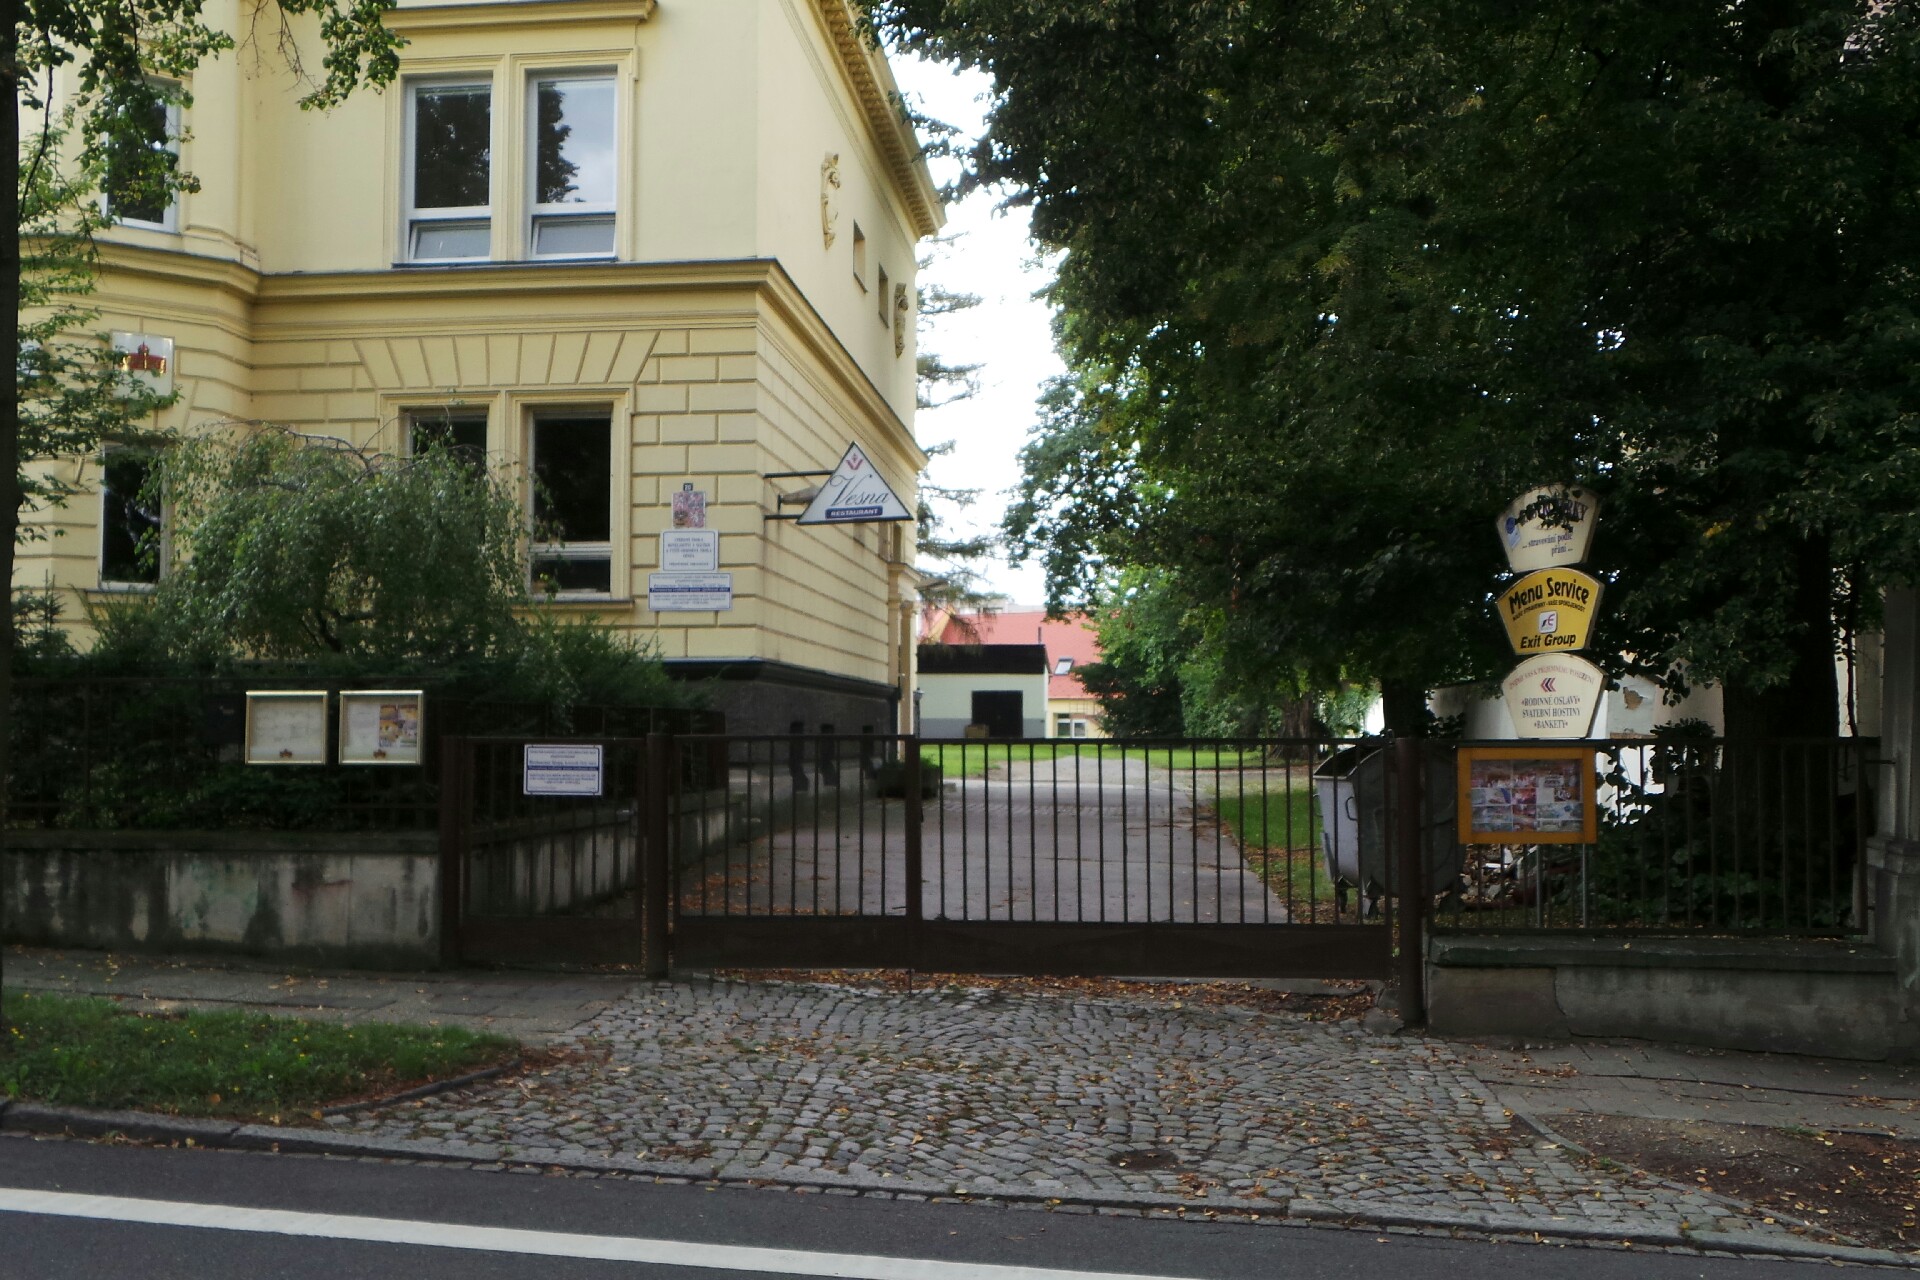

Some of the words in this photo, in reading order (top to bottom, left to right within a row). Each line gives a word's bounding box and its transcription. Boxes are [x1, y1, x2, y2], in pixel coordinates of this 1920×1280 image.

[829, 474, 889, 506] Vesna
[830, 508, 878, 517] RESTAURANT
[1508, 584, 1543, 615] Menu
[1546, 577, 1590, 605] Service
[1520, 635, 1541, 649] Exit
[1544, 634, 1576, 647] Group
[1524, 694, 1553, 706] RODINNÉ
[1553, 696, 1578, 705] OSLAVY
[1522, 707, 1551, 718] SVATEBNÍ
[1552, 708, 1580, 717] HOSTINY
[1536, 719, 1566, 729] BANKETY
